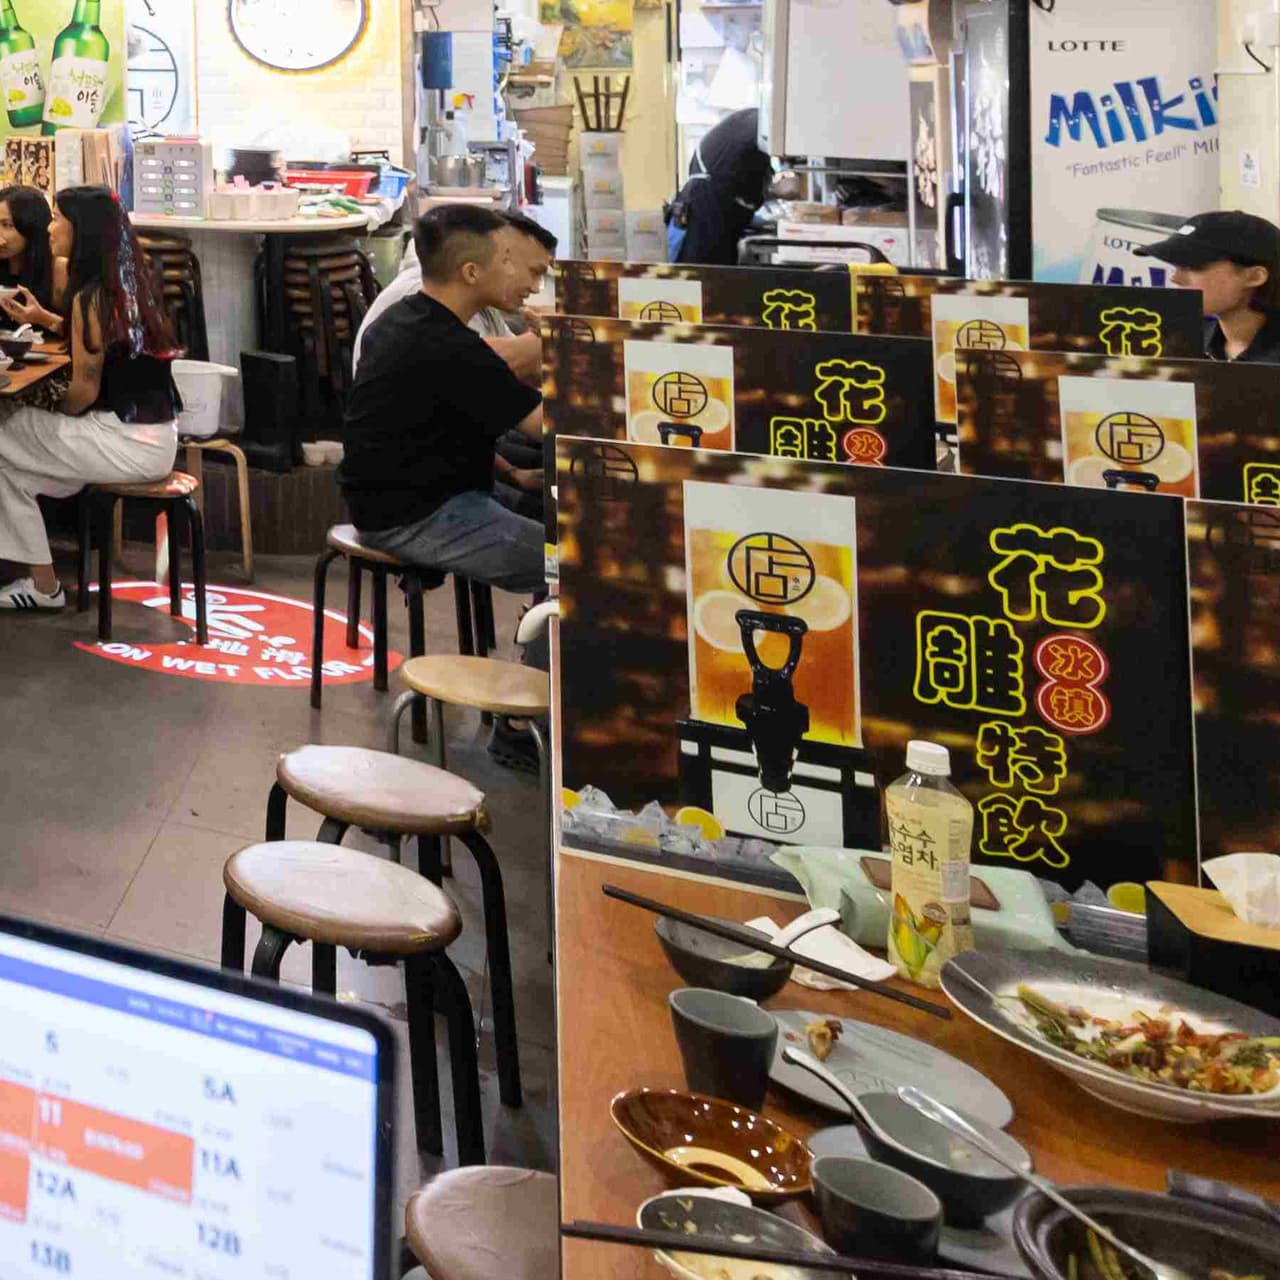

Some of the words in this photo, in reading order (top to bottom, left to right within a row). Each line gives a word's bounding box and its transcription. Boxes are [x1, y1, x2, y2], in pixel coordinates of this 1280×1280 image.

[1047, 39, 1126, 52] LOTTE
[1045, 74, 1219, 149] Milki
[160, 655, 240, 677] WET
